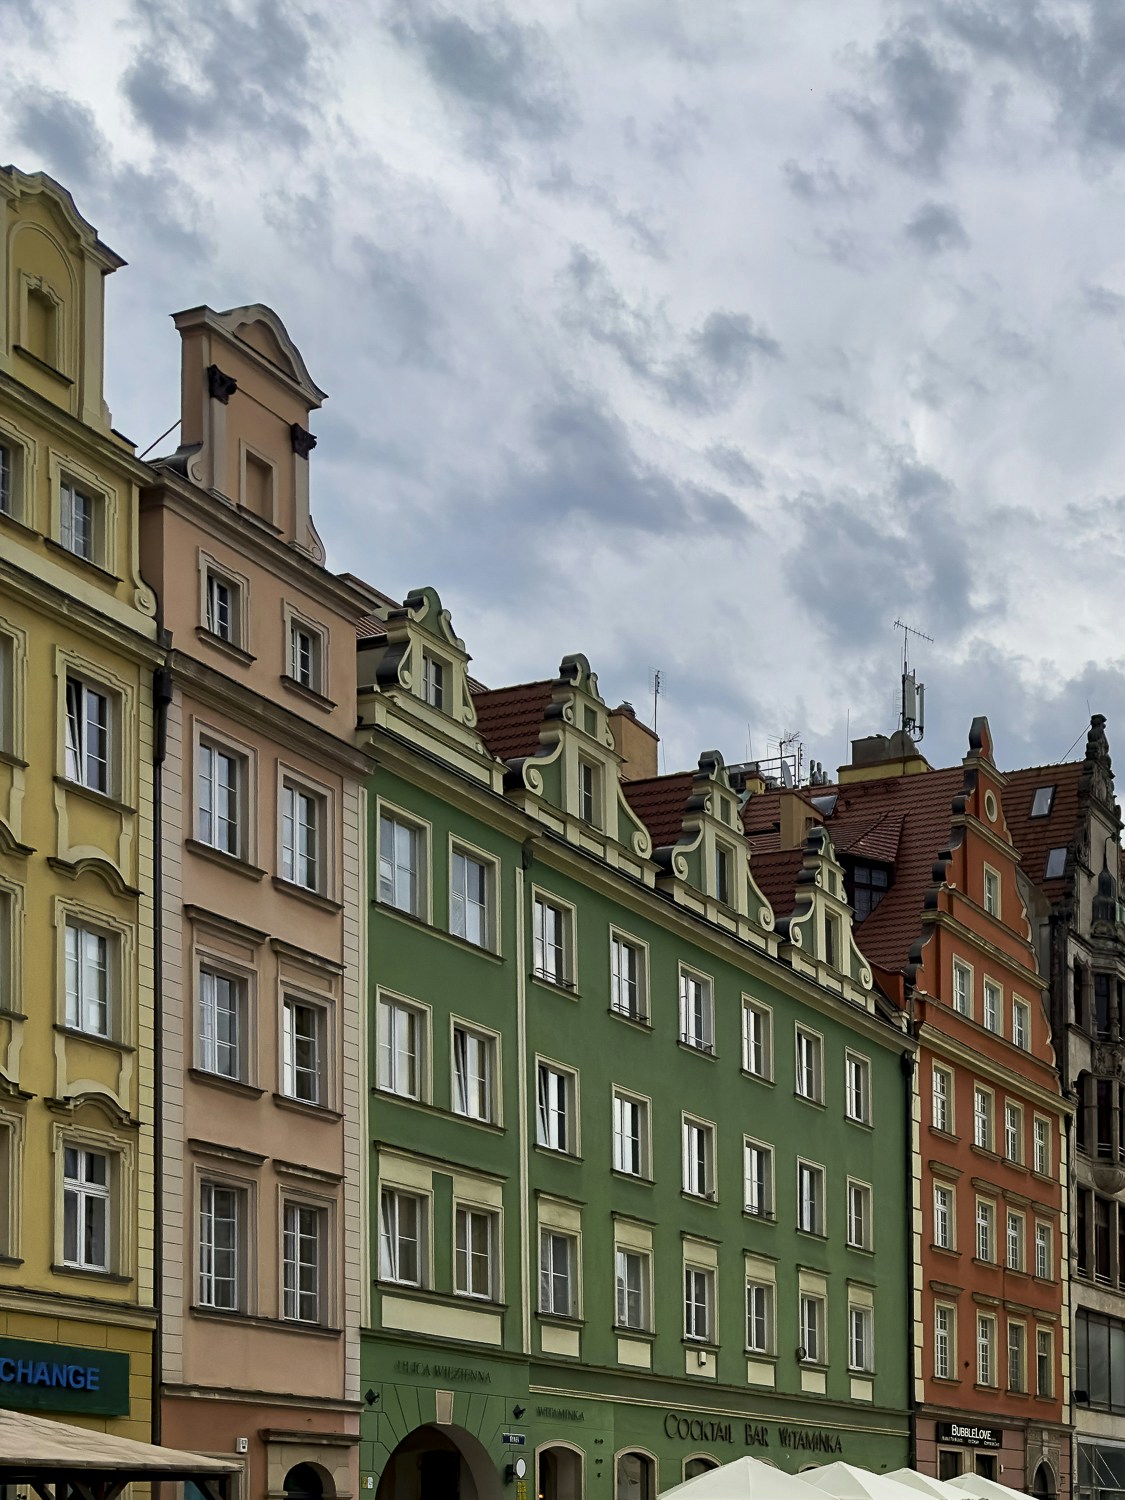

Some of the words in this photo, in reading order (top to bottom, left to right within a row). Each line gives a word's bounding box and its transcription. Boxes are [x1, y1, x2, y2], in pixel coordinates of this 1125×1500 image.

[664, 1412, 734, 1443] COCKTAIL
[744, 1423, 769, 1447] BAR
[778, 1427, 843, 1453] WITAMINKA
